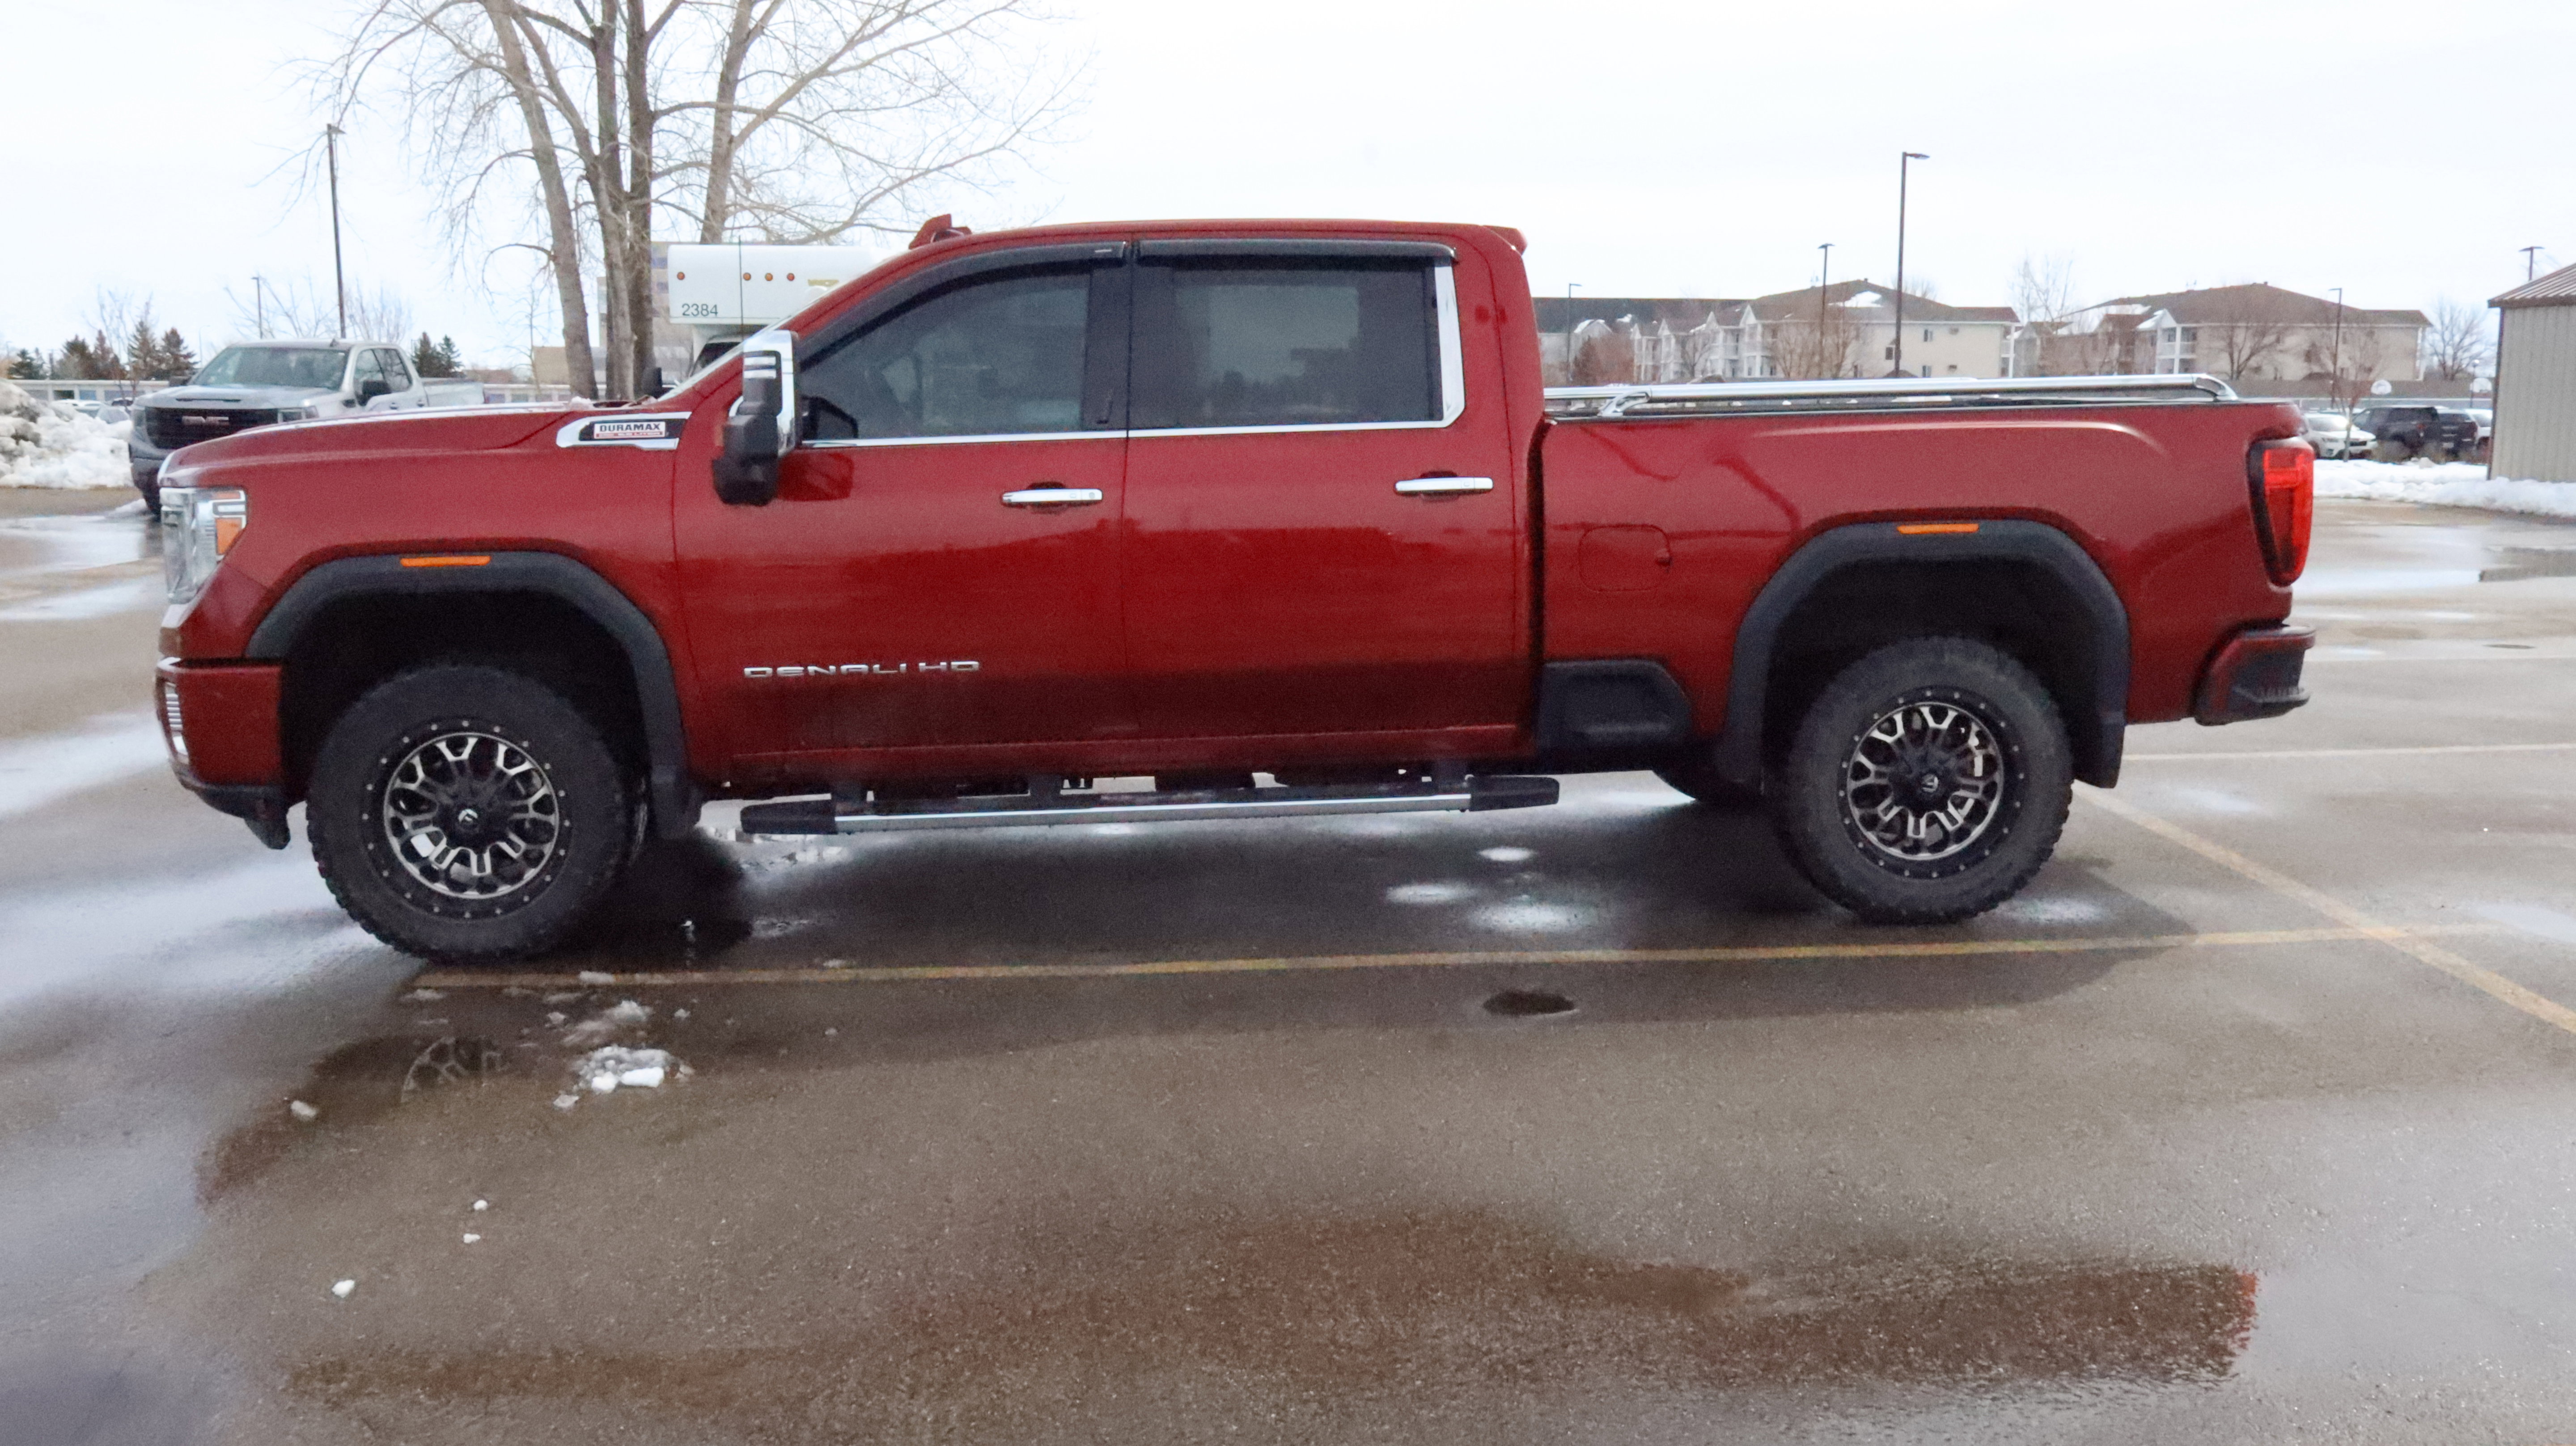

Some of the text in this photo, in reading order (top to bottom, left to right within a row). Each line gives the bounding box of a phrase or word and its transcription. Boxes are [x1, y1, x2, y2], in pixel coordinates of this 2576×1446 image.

[682, 304, 718, 317] 2384
[600, 424, 660, 432] DURAMAX
[744, 661, 980, 678] DENALI HD
